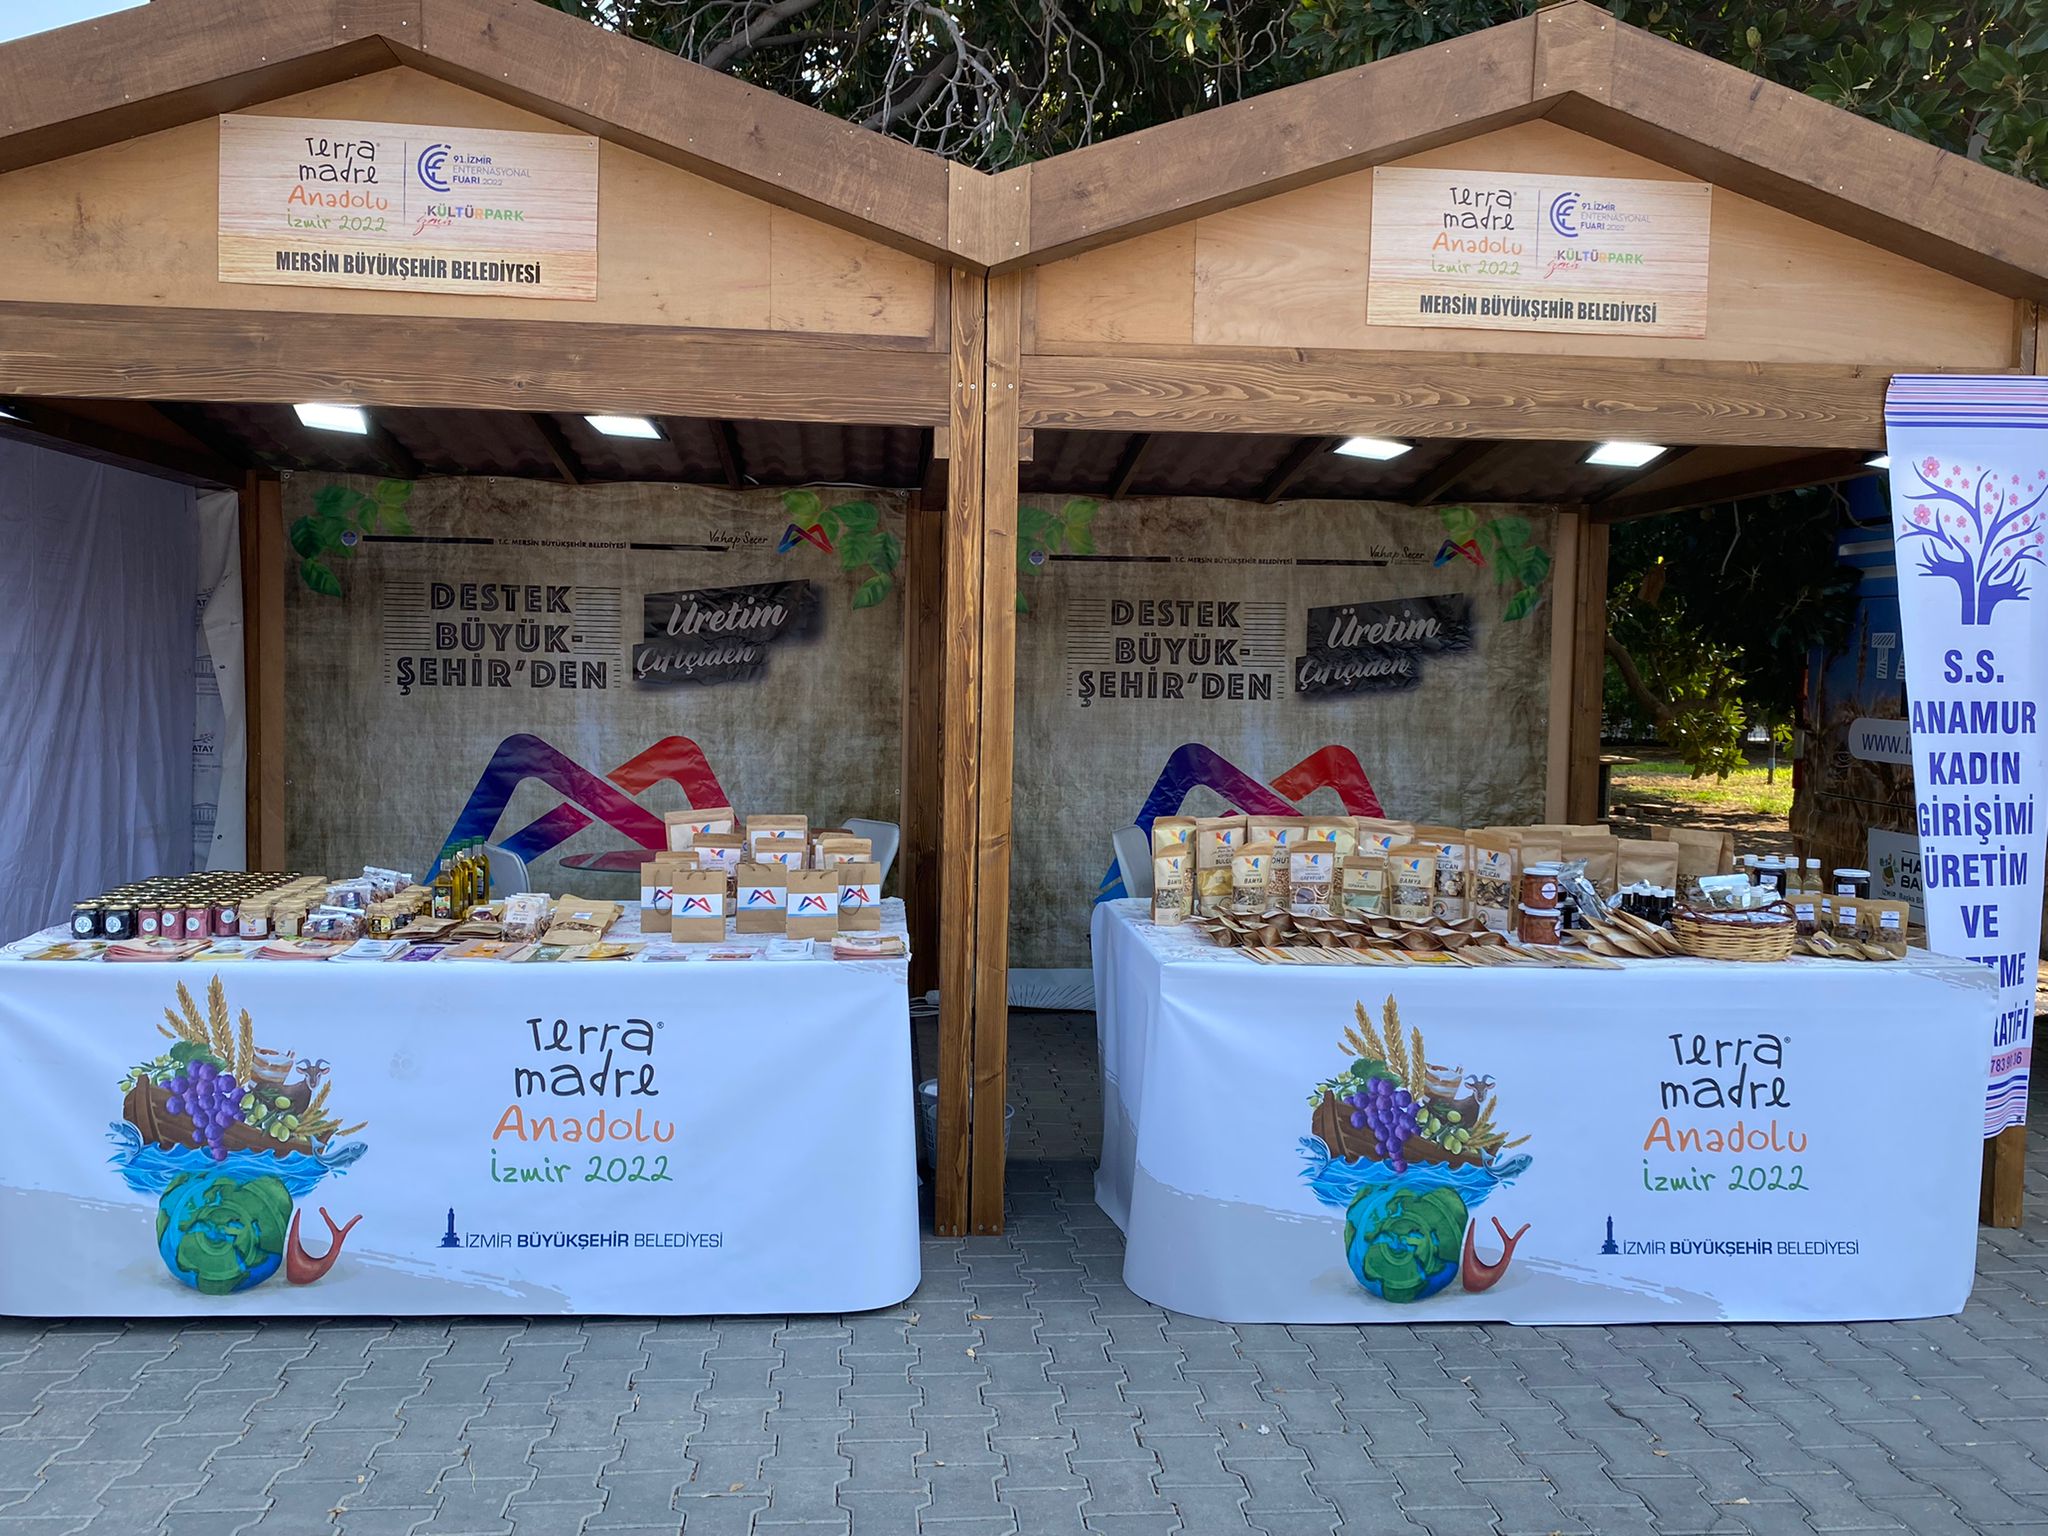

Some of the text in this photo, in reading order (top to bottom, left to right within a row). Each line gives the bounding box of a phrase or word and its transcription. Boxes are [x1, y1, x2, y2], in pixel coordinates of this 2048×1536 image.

[306, 138, 375, 162] Terra
[300, 156, 378, 184] madre
[452, 165, 531, 178] ENTERNASYONAL
[452, 176, 502, 186] FUARI 2022
[288, 184, 388, 210] Anadolu
[427, 203, 524, 222] KÜLTÜRPARK
[1450, 187, 1512, 209] Terra
[287, 209, 388, 232] İzmir 2022
[1444, 205, 1514, 231] madre
[1580, 212, 1651, 223] ENTERNASYONAL
[1580, 222, 1605, 230] FUARI
[1432, 232, 1522, 256] Anadolu
[1556, 250, 1644, 264] KÜLTÜRPARK
[276, 250, 541, 283] MERSİN BÜYÜKŞEHİR BELEDİYESİ
[1432, 254, 1520, 276] İzmir 2022
[1420, 293, 1656, 323] MERSİN BÜYÜKŞEHİR BELEDİYESİ
[512, 538, 539, 546] MERSİN
[541, 539, 587, 548] BÜYÜKŞEHİR
[588, 541, 626, 549] BELEDİYESİ
[709, 529, 740, 549] Vahap
[1188, 556, 1212, 564] MERSİN
[1214, 557, 1257, 565] BÜYÜKŞEHİR
[430, 582, 572, 614] DESTEK
[667, 594, 788, 637] Üretim
[1111, 600, 1241, 628] DESTEK
[1327, 608, 1442, 649] Üretim
[436, 618, 584, 654] BÜYÜK-
[1115, 632, 1252, 666] BÜYÜK-
[397, 652, 608, 696] ŞEHİR'DEN
[1944, 649, 2004, 684] S.S.
[1078, 666, 1272, 708] ŞEHİR'DEN
[1912, 701, 2036, 734] ANAMUR
[1929, 752, 2020, 785] KADIN
[1918, 794, 2034, 845] GİRİŞİMİ
[1399, 877, 1421, 885] BAMYA
[1924, 845, 2028, 889] ÜRETİM
[1960, 905, 1999, 938] VE
[526, 1018, 654, 1055] Terra
[1668, 1034, 1782, 1069] Terra
[515, 1049, 659, 1098] madre
[1660, 1062, 1791, 1109] madre
[492, 1104, 675, 1144] Anadolu
[1643, 1116, 1808, 1153] Anadolu
[491, 1148, 674, 1184] İzmir 2022
[1643, 1158, 1809, 1191] İzmir 2022
[465, 1230, 723, 1250] İZMİR BÜYÜKŞEHİR BELEDİYESİ
[1623, 1238, 1859, 1258] İZMİR BÜYÜKŞEHİR BELEDİYESİ
